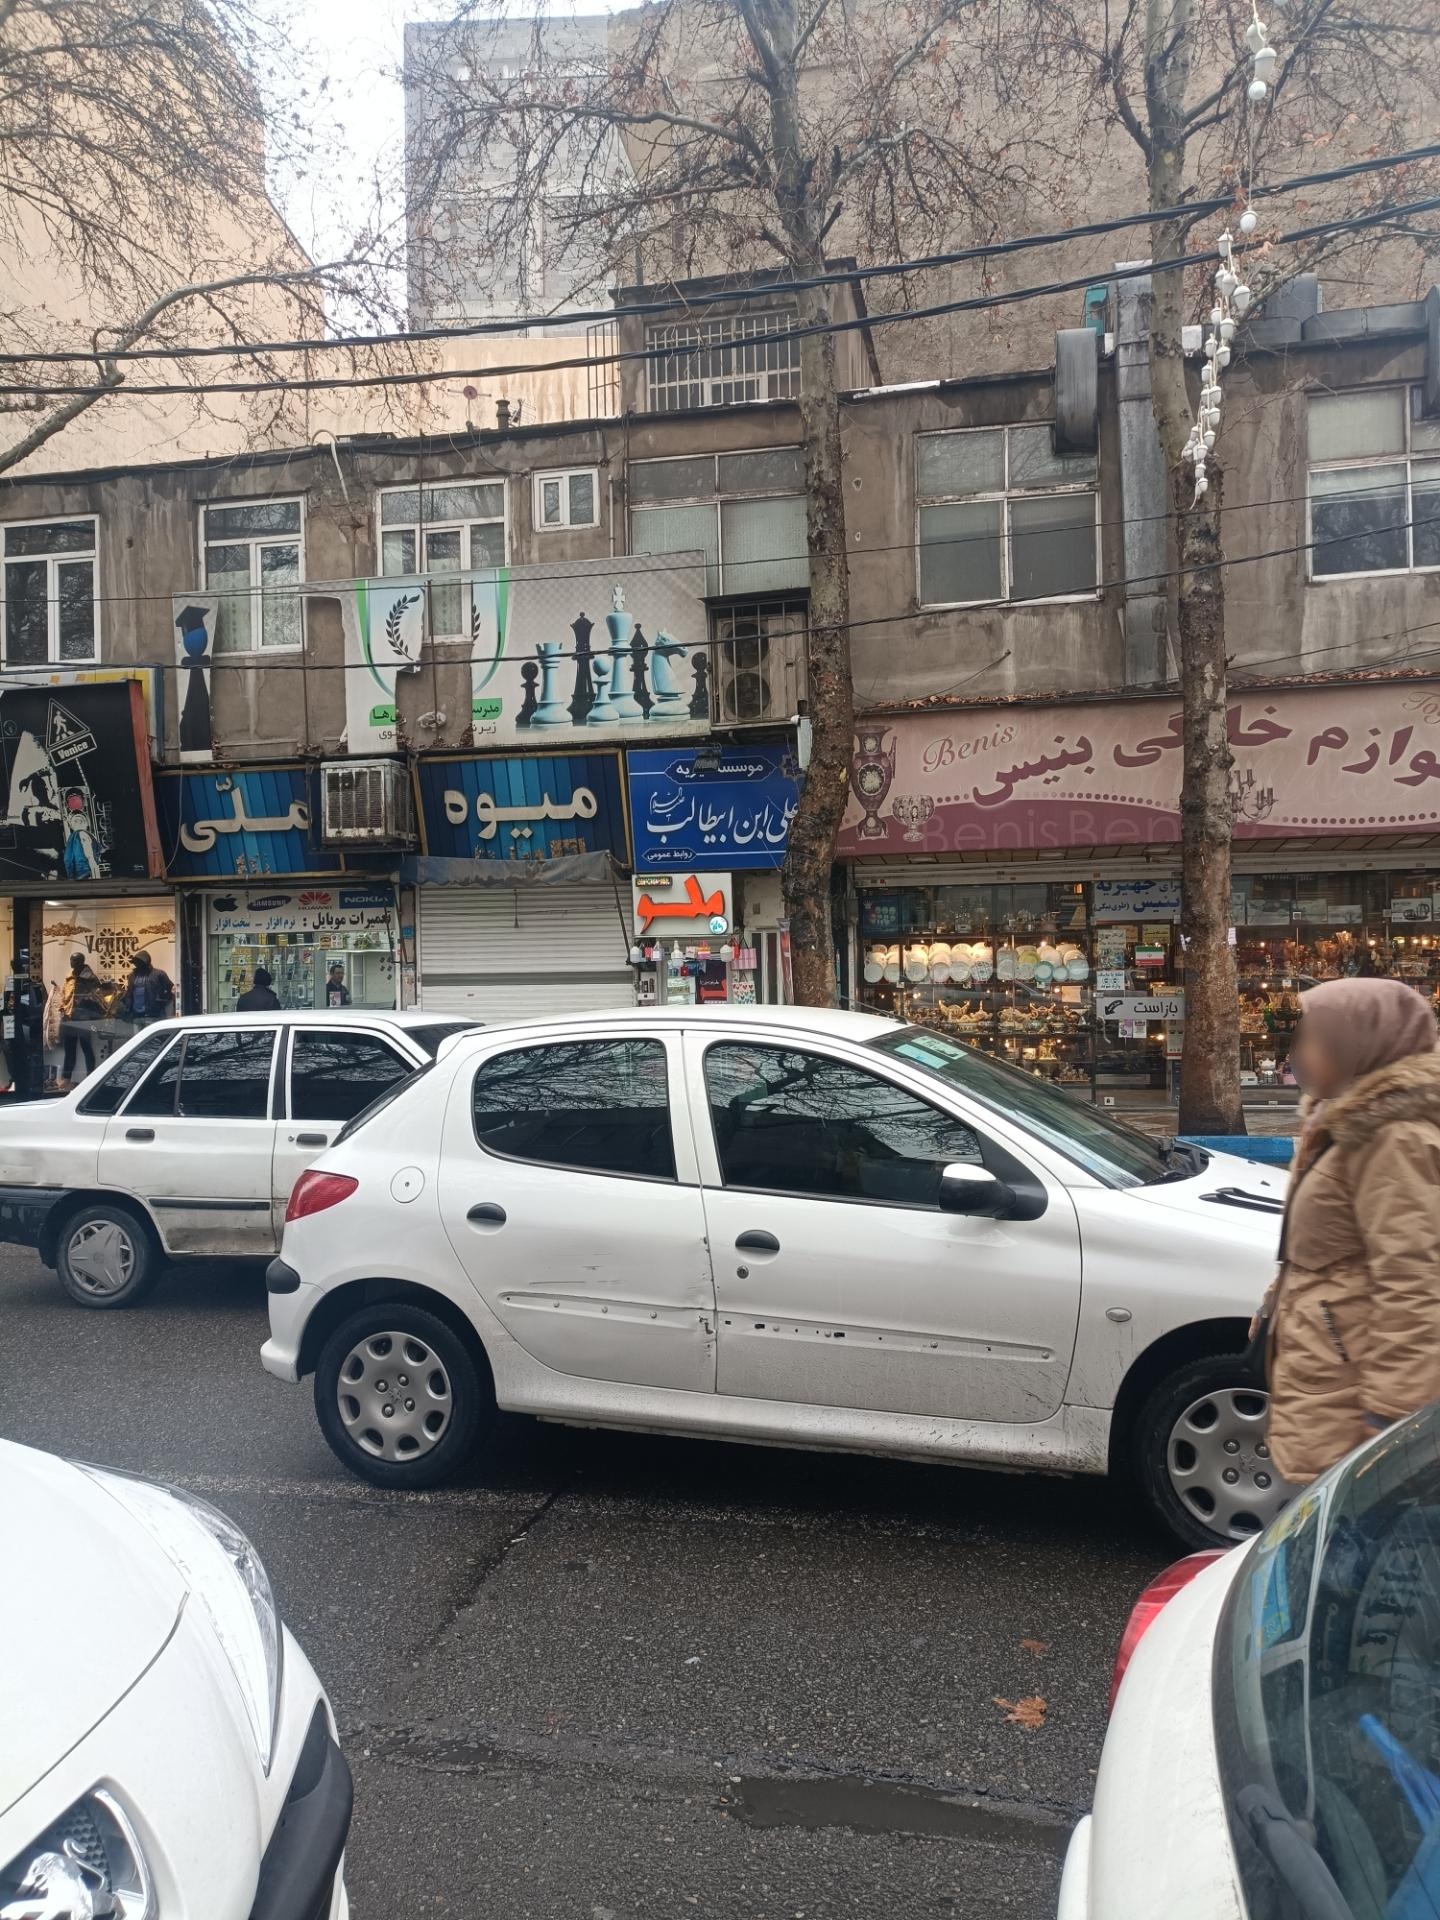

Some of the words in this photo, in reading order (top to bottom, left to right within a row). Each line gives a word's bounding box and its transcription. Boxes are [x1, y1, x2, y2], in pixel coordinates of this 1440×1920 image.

[472, 704, 499, 717] مدرس
[1113, 705, 1293, 767] خاگی
[57, 740, 90, 760] Venice
[922, 723, 1017, 773] Benis
[1307, 725, 1440, 787] وازم
[717, 763, 764, 777] موسس
[972, 735, 1095, 806] بنیس
[443, 786, 598, 841] میوه
[766, 797, 799, 844] علی
[733, 803, 769, 845] ابن
[647, 852, 672, 862] عمومی
[672, 849, 693, 861] روابط
[344, 896, 390, 904] NOKIA
[1133, 896, 1180, 913] بنیس
[214, 917, 231, 932] افزار
[232, 917, 251, 929] سخت
[265, 916, 282, 931] افزار
[284, 915, 296, 930] نرم
[312, 911, 346, 930] موبایل
[350, 909, 392, 930] تعمیرات
[84, 934, 140, 954] Venice
